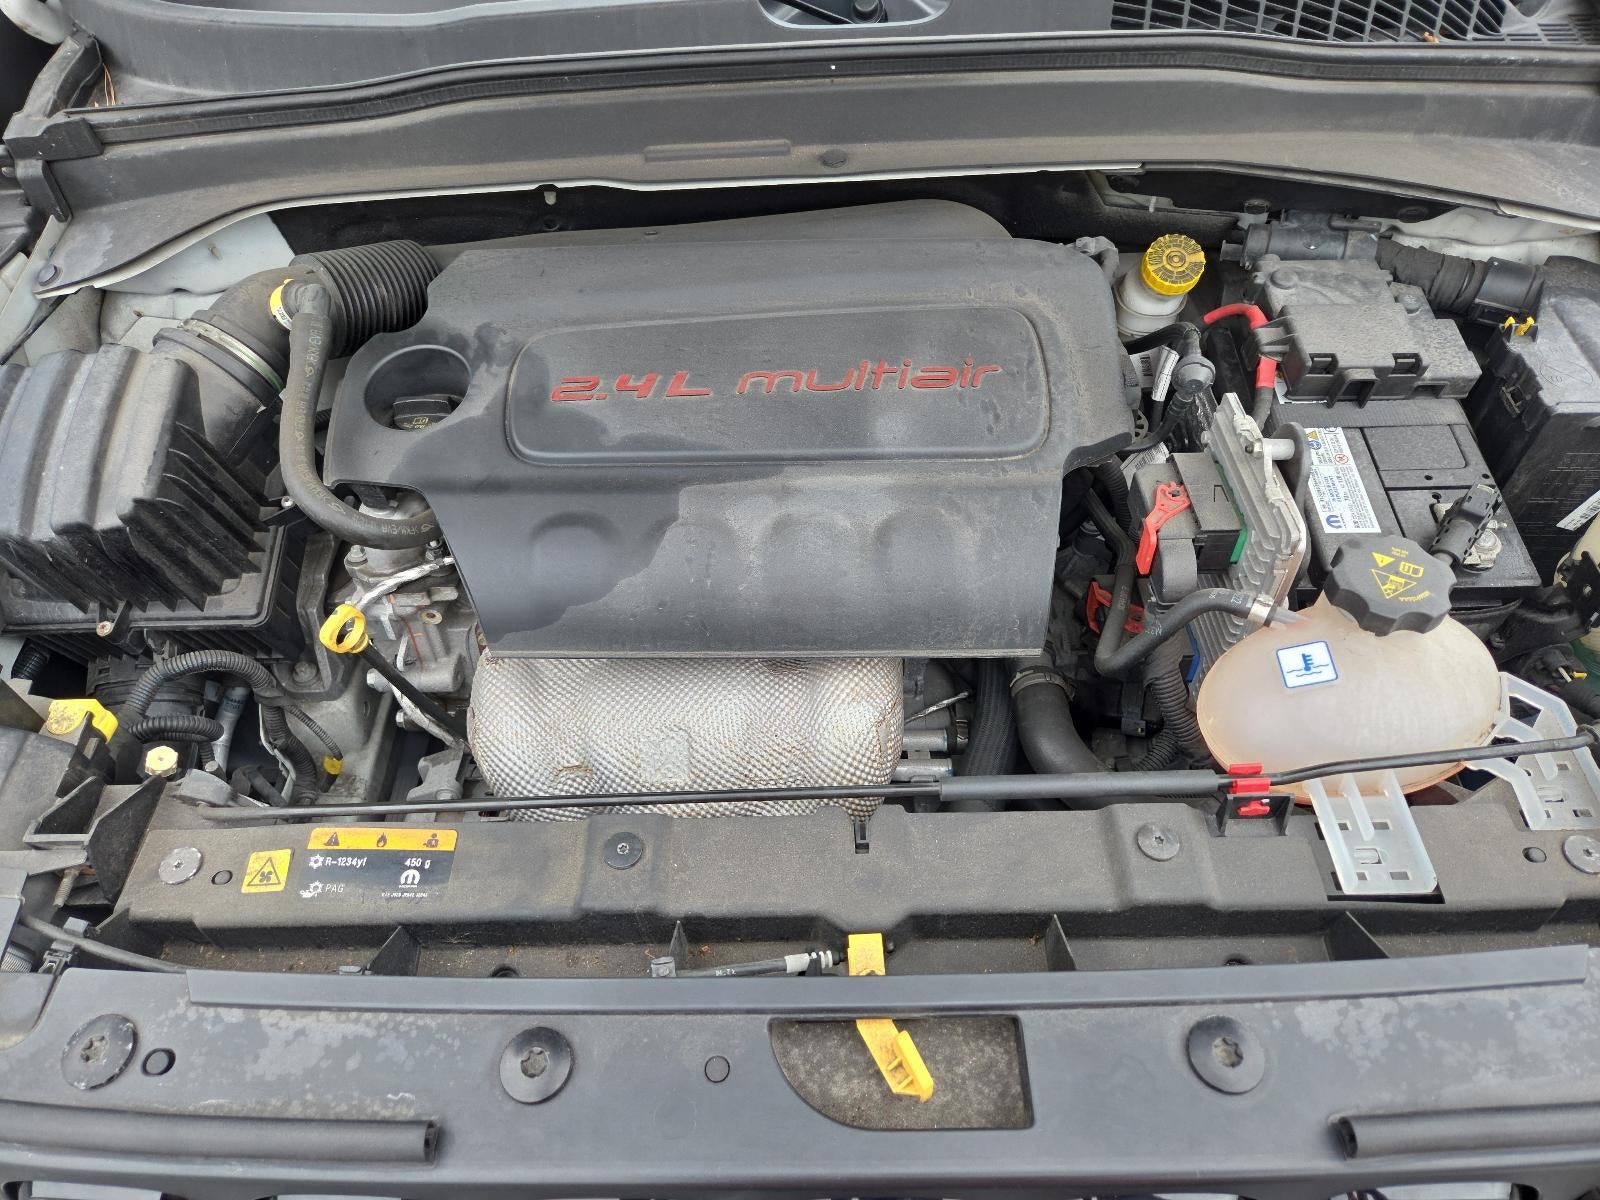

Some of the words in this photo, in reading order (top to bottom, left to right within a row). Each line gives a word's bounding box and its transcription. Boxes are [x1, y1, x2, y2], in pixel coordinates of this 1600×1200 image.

[736, 354, 1000, 395] multiair
[325, 856, 367, 868] R-1234yf
[404, 858, 422, 867] 450
[325, 883, 344, 893] PAG
